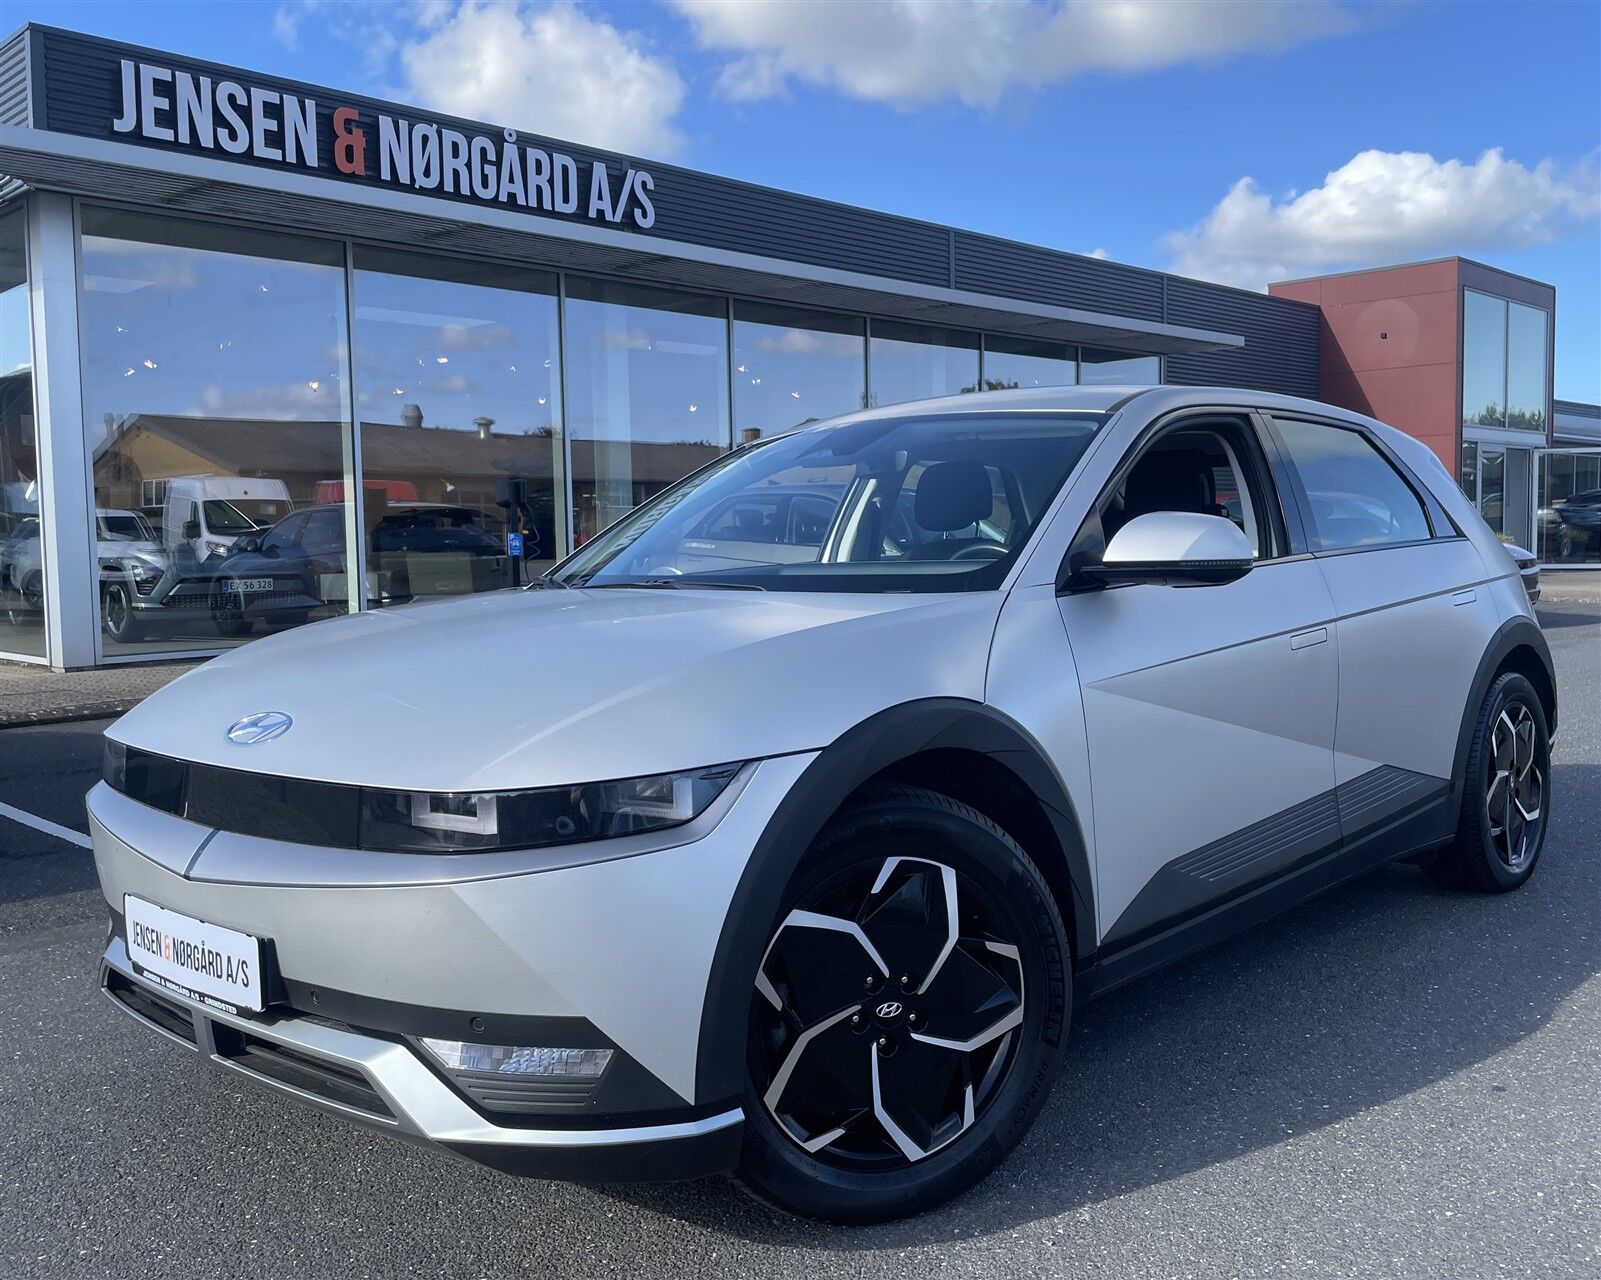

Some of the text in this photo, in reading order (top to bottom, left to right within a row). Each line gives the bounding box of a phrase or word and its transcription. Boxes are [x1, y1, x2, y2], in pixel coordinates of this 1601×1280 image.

[113, 58, 656, 230] JENSEN & NØRGÅRD A/S
[244, 581, 255, 590] 56
[257, 580, 272, 589] 328
[133, 920, 250, 989] JENSEN & NØRGÅRD A/S
[142, 970, 161, 984] JENSEN
[1038, 914, 1063, 1041] MICHELIN
